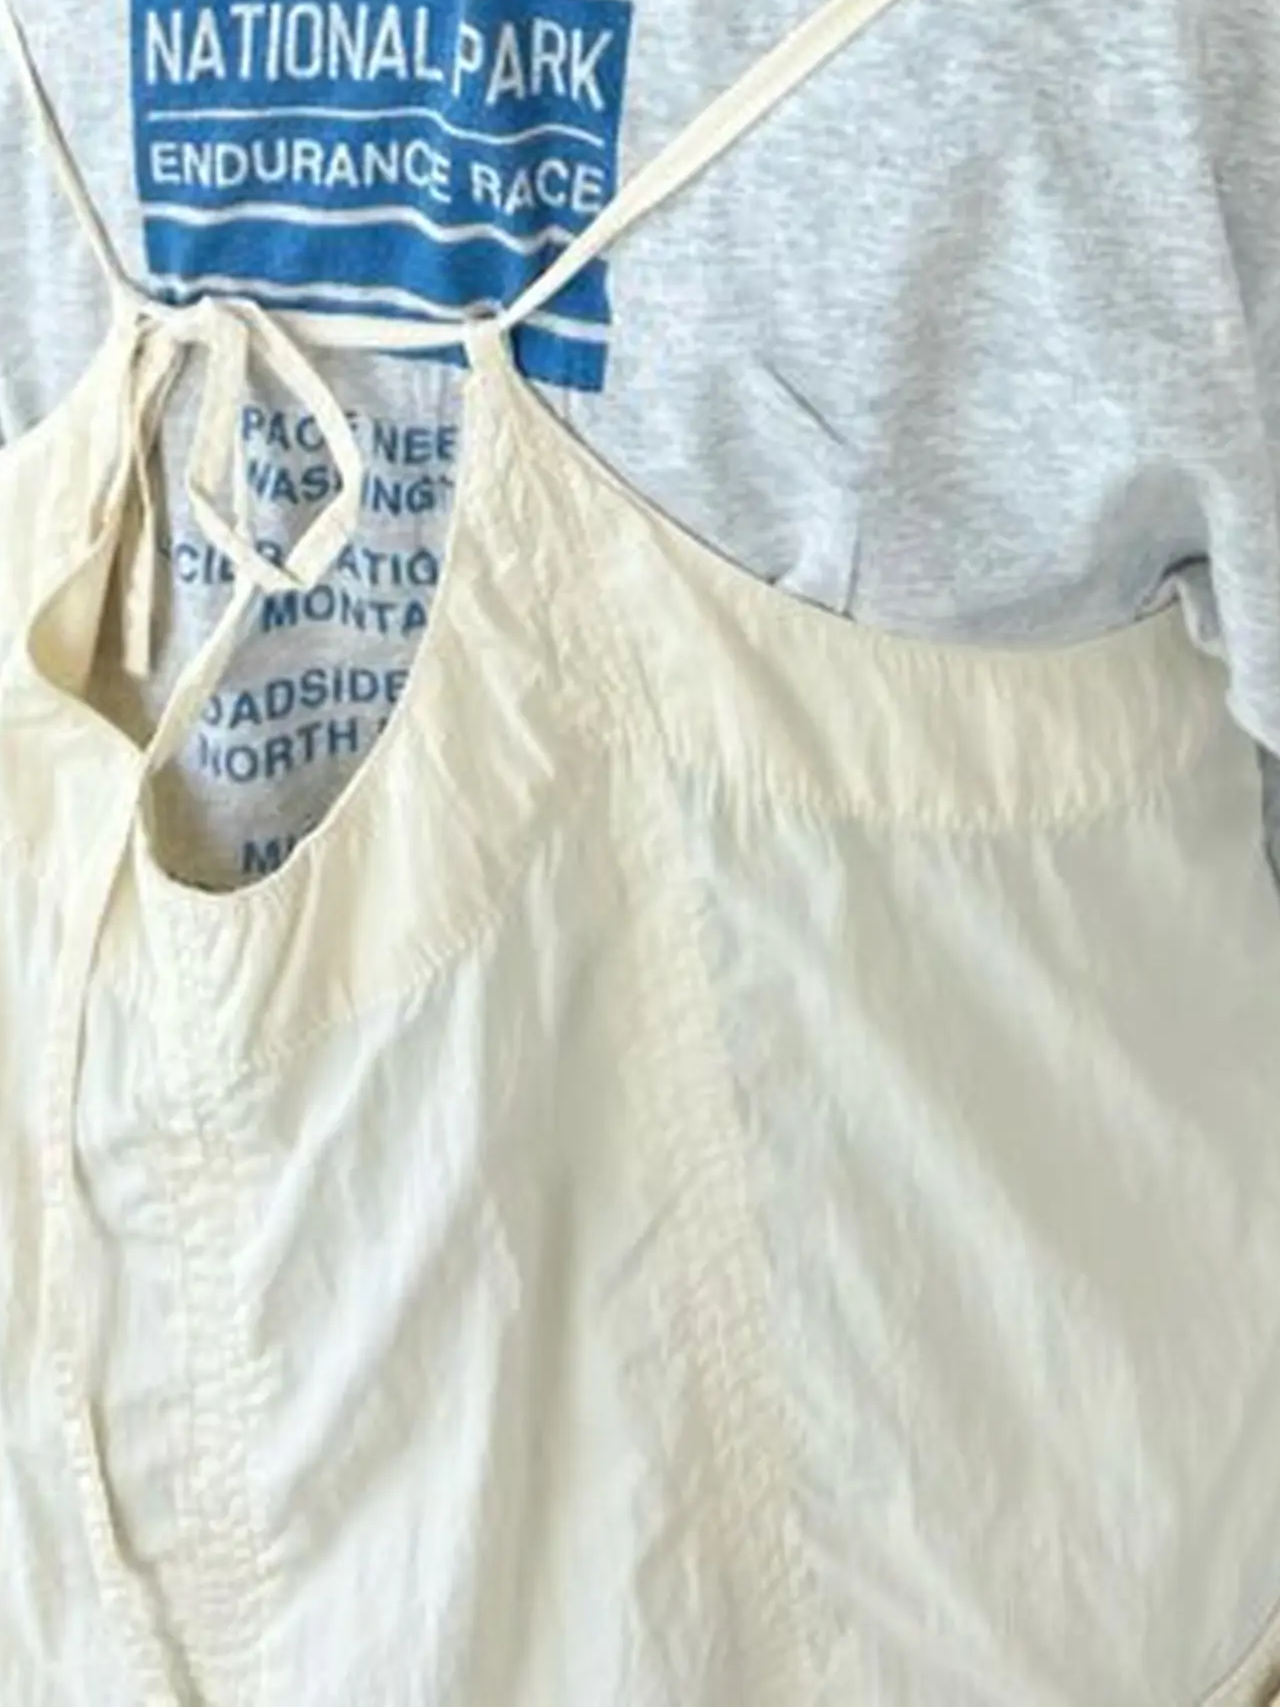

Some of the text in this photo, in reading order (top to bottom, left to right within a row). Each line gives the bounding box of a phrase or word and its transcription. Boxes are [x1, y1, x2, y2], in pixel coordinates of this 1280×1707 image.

[146, 3, 613, 111] NATIONAL PARK
[150, 139, 605, 215] ENDURANCE RACE
[242, 406, 358, 453] PAC
[240, 833, 300, 874] M
